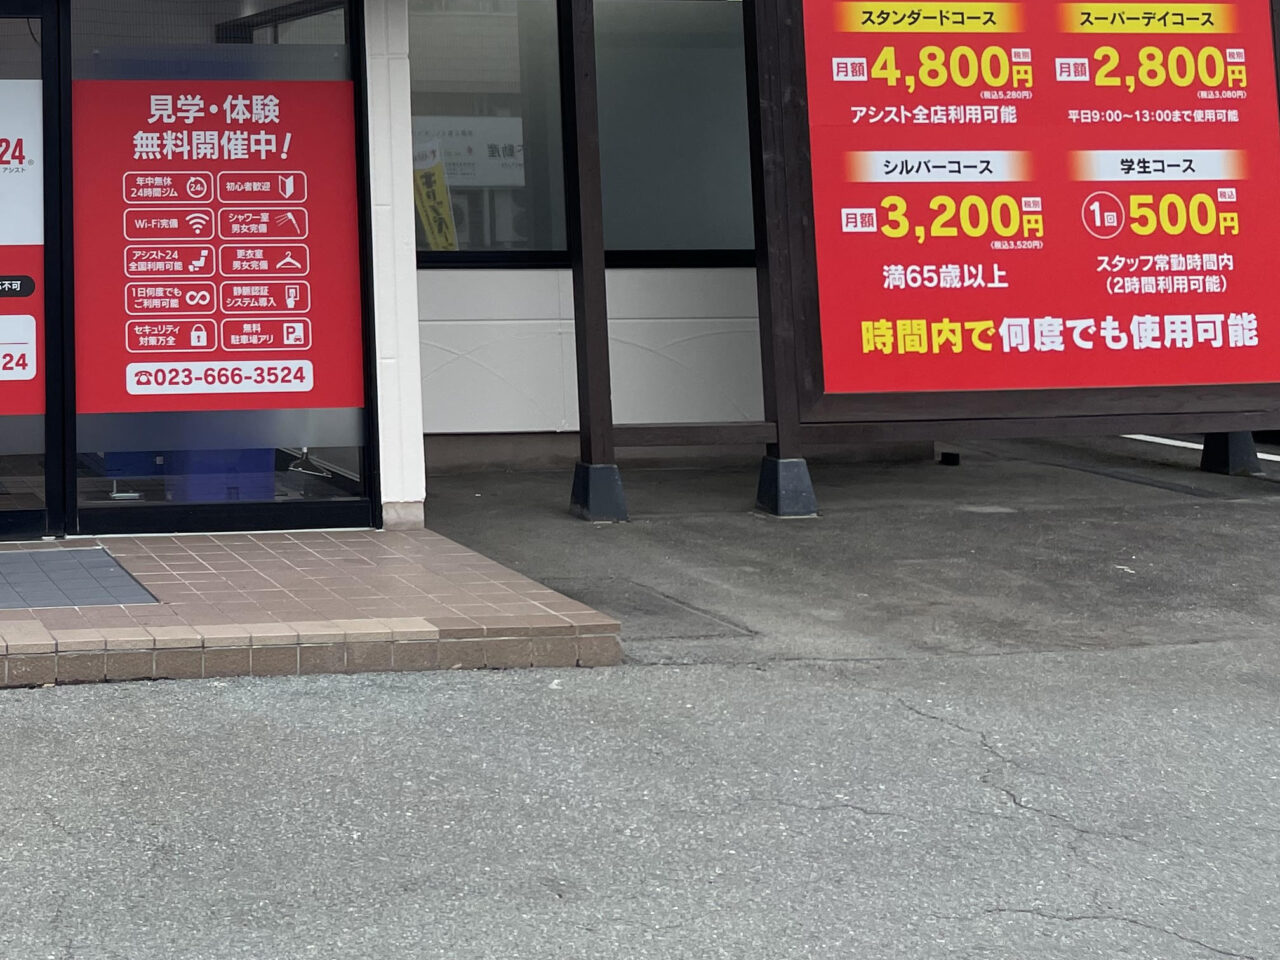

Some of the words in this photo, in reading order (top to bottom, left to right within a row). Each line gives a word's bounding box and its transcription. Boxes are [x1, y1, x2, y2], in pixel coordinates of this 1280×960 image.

[861, 9, 997, 26] スタンダードコース
[1080, 10, 1214, 27] スーパーデイコース
[836, 62, 865, 77] 月額
[1059, 62, 1087, 78] 月額
[147, 94, 280, 124] 見学・体験
[851, 104, 1017, 124] アシスト全店利用可能
[132, 130, 292, 160] 無料開催中!
[883, 158, 994, 176] シルバーコース
[1120, 157, 1196, 175] 学生コース
[136, 177, 172, 187] 年中無休
[130, 188, 178, 198] 24時間ジム
[229, 213, 270, 223] シャワー室
[845, 212, 875, 228] 月額
[1089, 201, 1118, 227] 1回
[1129, 193, 1240, 236] 500円
[134, 218, 179, 229] Wi-Fi完備
[132, 250, 179, 260] アシスト24
[1096, 253, 1234, 272] スタッフ常勤時間内
[128, 262, 183, 271] 全国利用可能
[882, 263, 1009, 290] 満65歳以上
[1106, 274, 1227, 294] (2時間利用可能)
[134, 299, 180, 309] ご利用可能
[226, 297, 277, 308] システム導入
[134, 325, 180, 334] セキュリティ
[243, 323, 261, 333] 無料
[860, 312, 1259, 355] 時間内で何度でも使用可能
[154, 366, 306, 386] 023-666-3524
